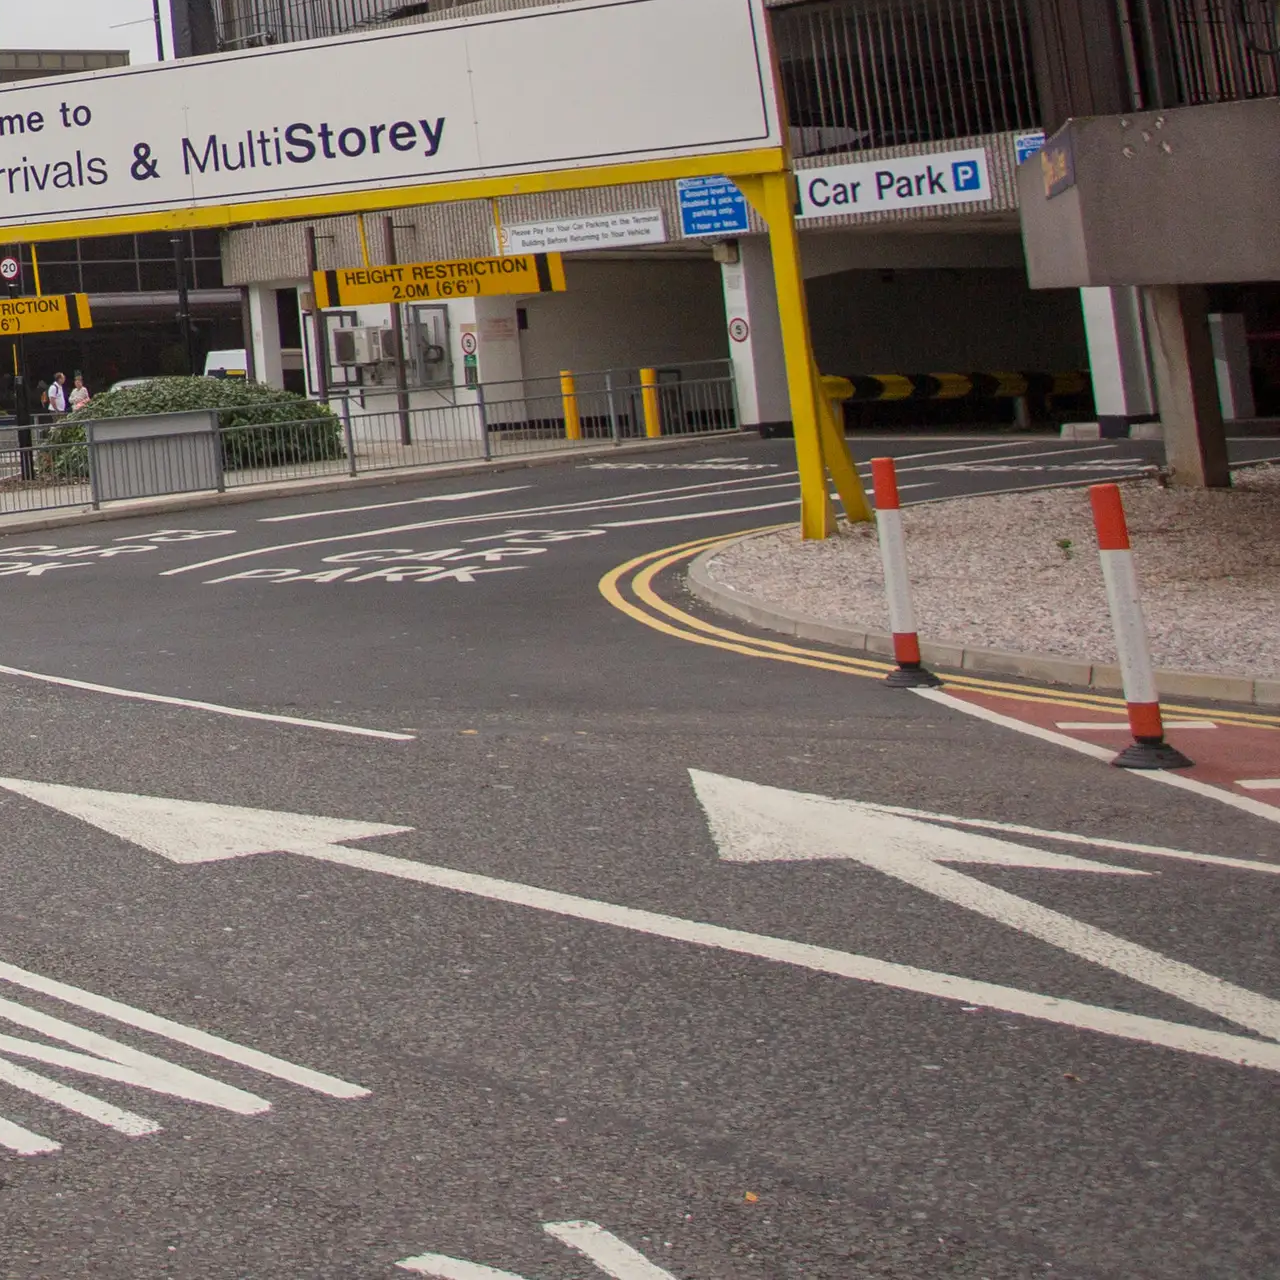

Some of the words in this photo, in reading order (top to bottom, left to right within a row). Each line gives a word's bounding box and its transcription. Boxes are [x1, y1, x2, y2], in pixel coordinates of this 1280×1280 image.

[59, 102, 92, 127] to
[131, 143, 160, 181] &
[181, 117, 445, 175] MultiStorey
[808, 178, 861, 207] Car
[875, 165, 947, 200] Park
[533, 227, 544, 236] Pay
[573, 223, 584, 231] Car
[586, 220, 609, 230] Parking
[522, 238, 545, 248] Building
[547, 236, 568, 245] Before
[2, 263, 16, 273] 20
[345, 268, 404, 286] HEIGHT
[412, 258, 527, 282] RESTRICTION
[392, 284, 429, 300] 2.0M
[114, 529, 237, 542] T3
[461, 529, 607, 543] T3
[322, 547, 547, 563] CAR
[202, 565, 531, 584] PARK
